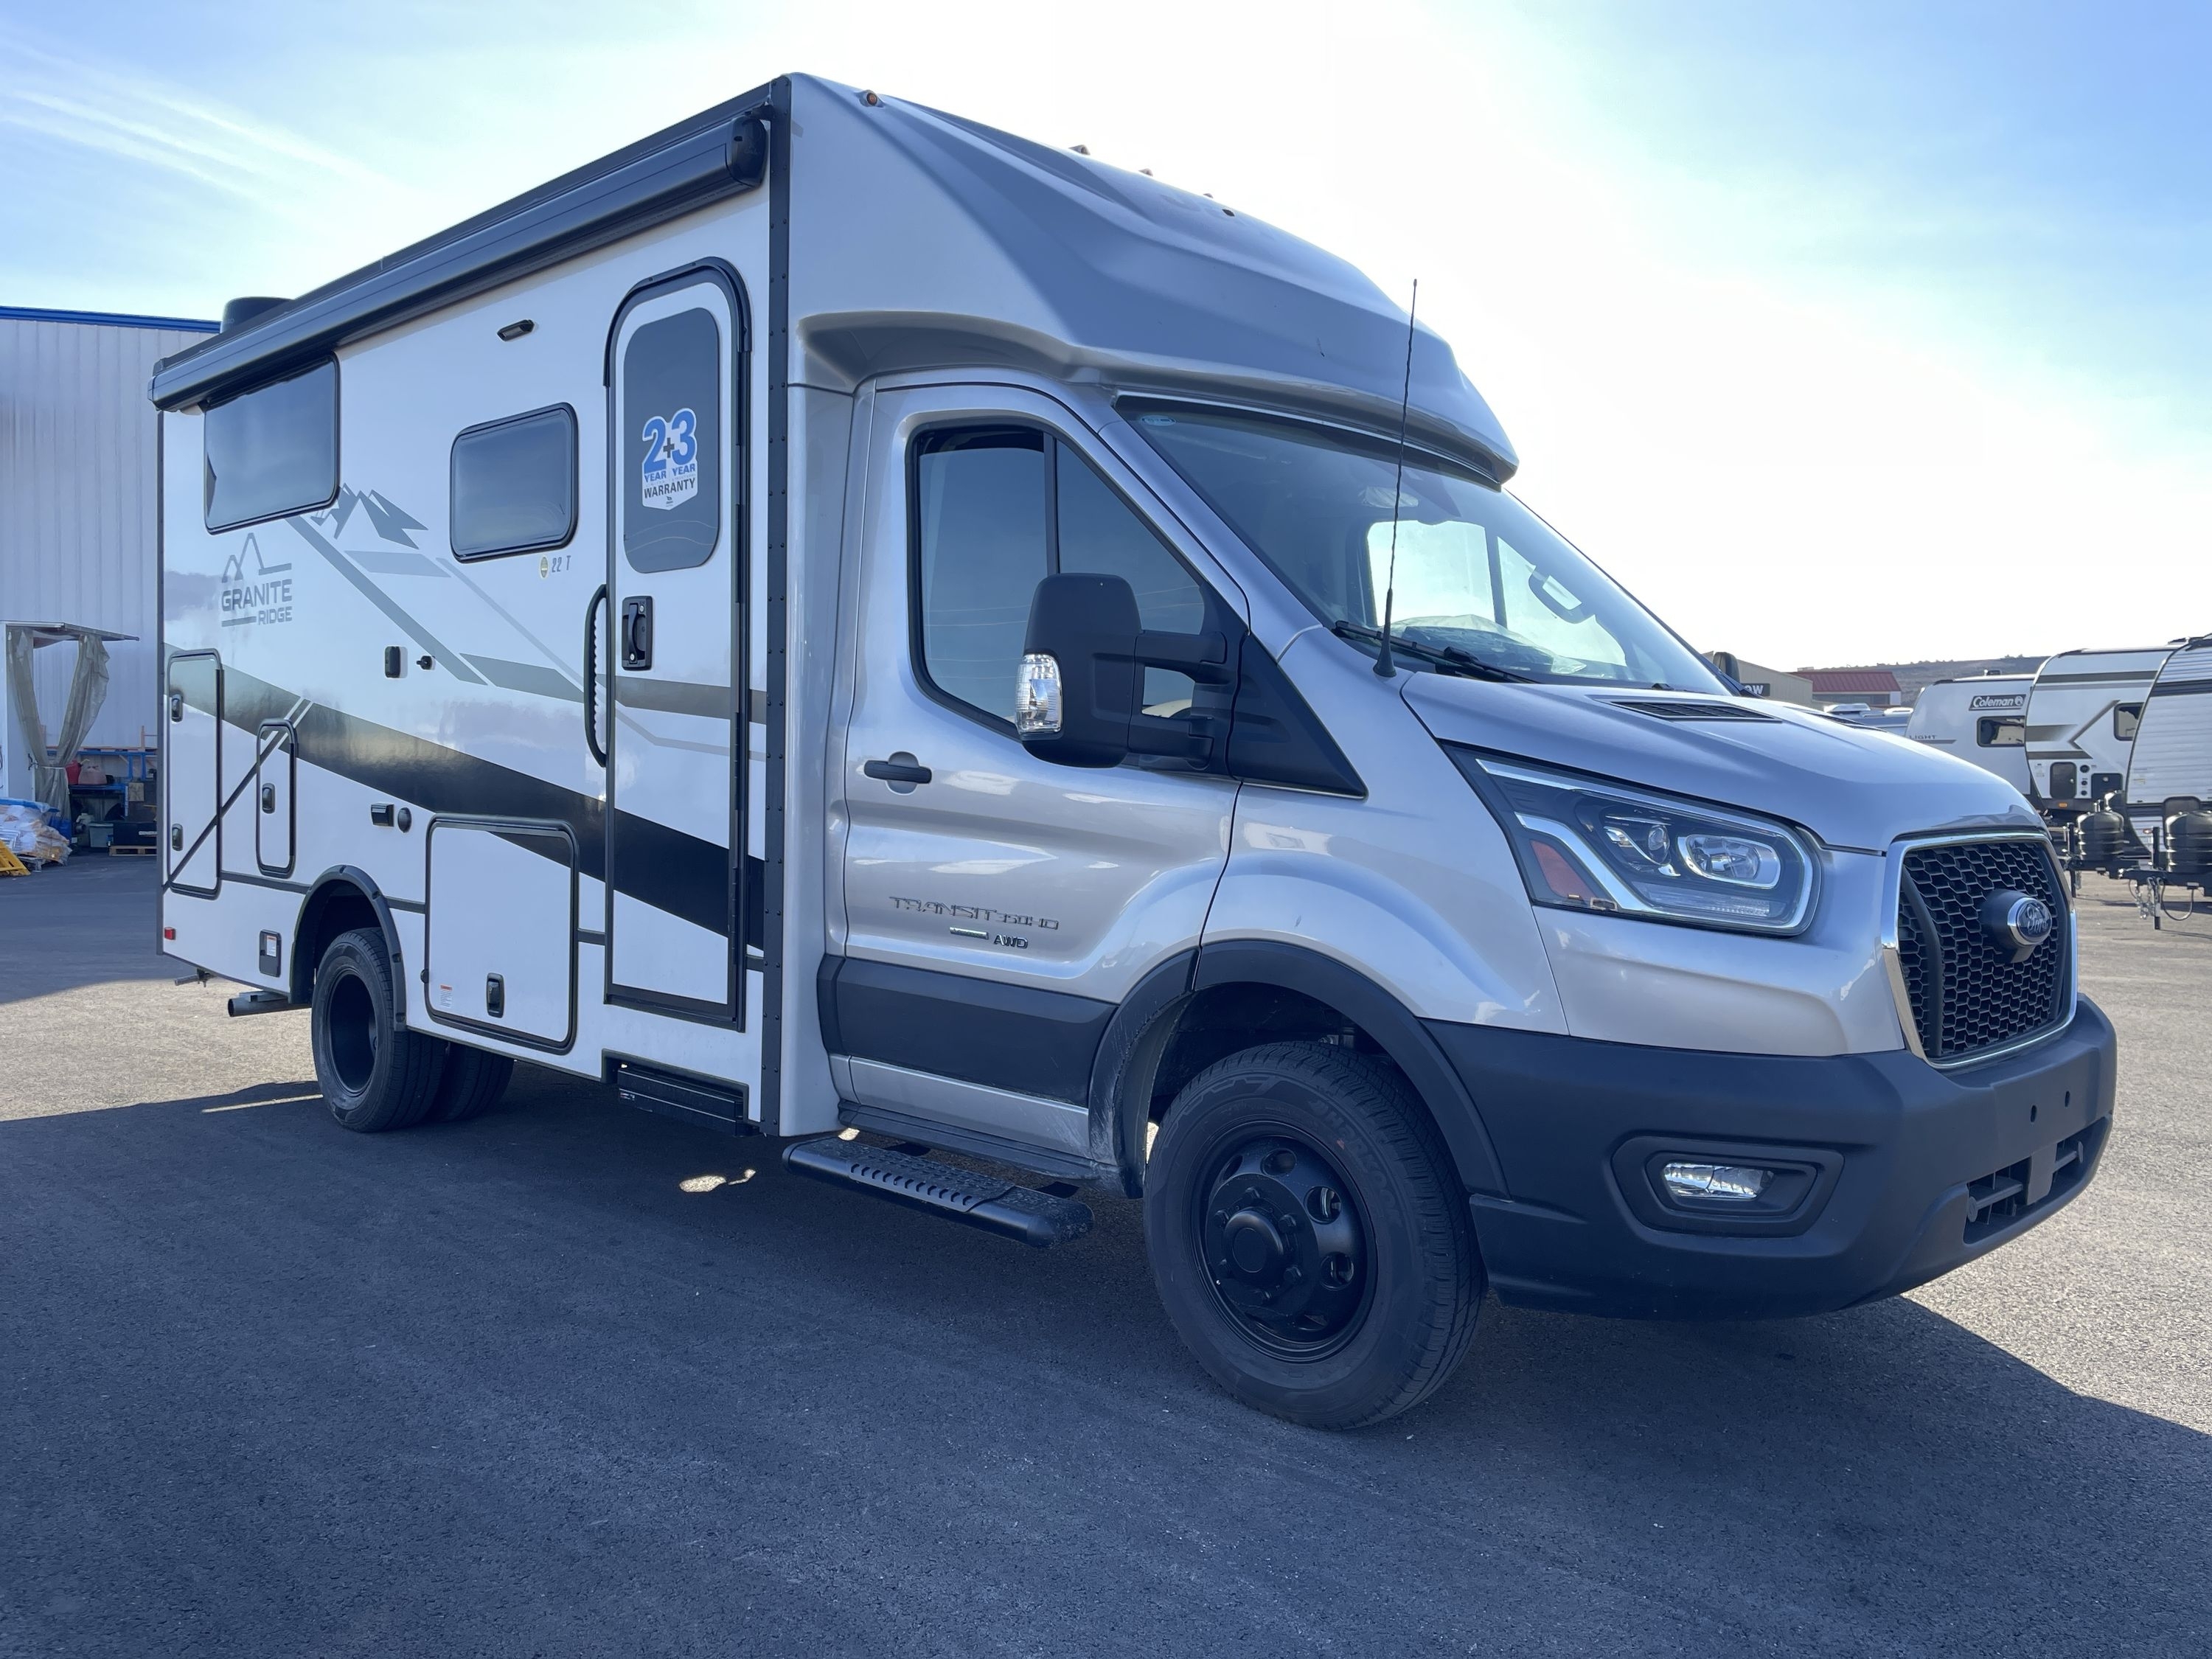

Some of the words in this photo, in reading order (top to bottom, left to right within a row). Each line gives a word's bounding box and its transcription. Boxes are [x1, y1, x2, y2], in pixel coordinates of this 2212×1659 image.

[644, 470, 667, 483] YEAR
[672, 463, 695, 476] YEAR
[644, 478, 695, 498] WARRANTY
[552, 557, 562, 572] 22
[222, 579, 292, 612] GRANITE
[259, 606, 292, 625] RIDGE
[1973, 696, 2014, 708] Coleman
[889, 896, 997, 921] TRANSIT
[2025, 905, 2050, 934] Ford
[994, 933, 1029, 949] AWD
